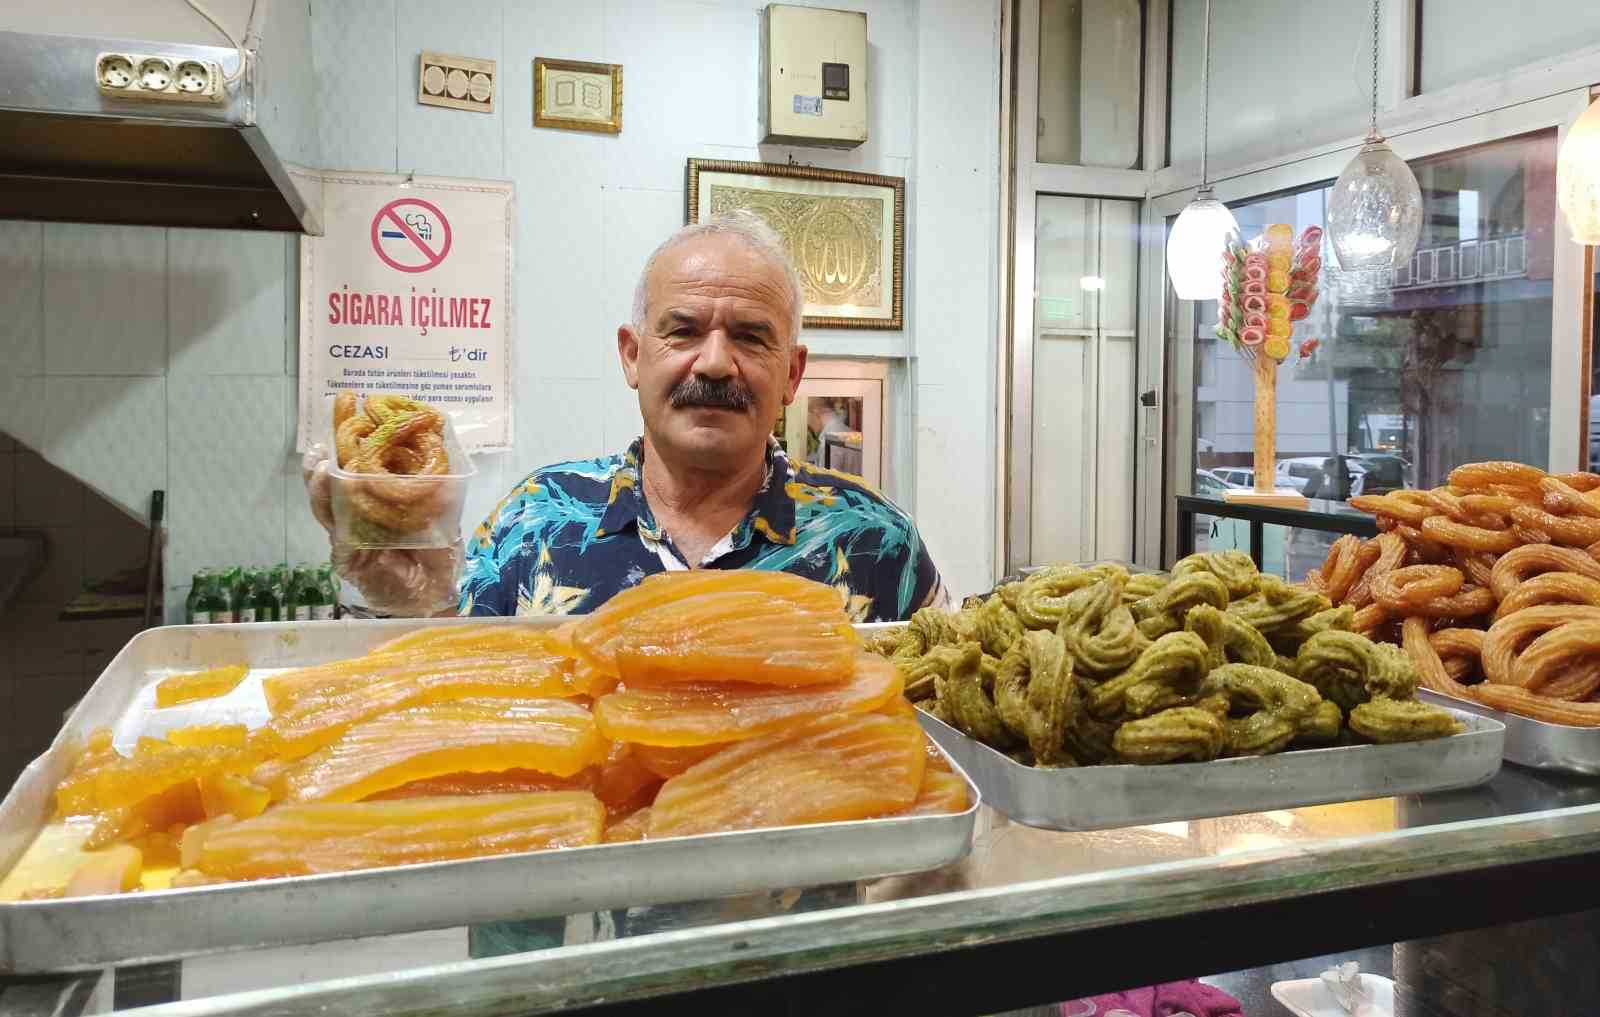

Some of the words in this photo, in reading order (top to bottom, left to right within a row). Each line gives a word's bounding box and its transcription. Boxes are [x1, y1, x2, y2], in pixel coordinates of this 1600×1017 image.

[328, 284, 404, 326] SİGARA
[411, 286, 492, 336] İÇİLMEZ
[329, 344, 389, 359] CEZASI
